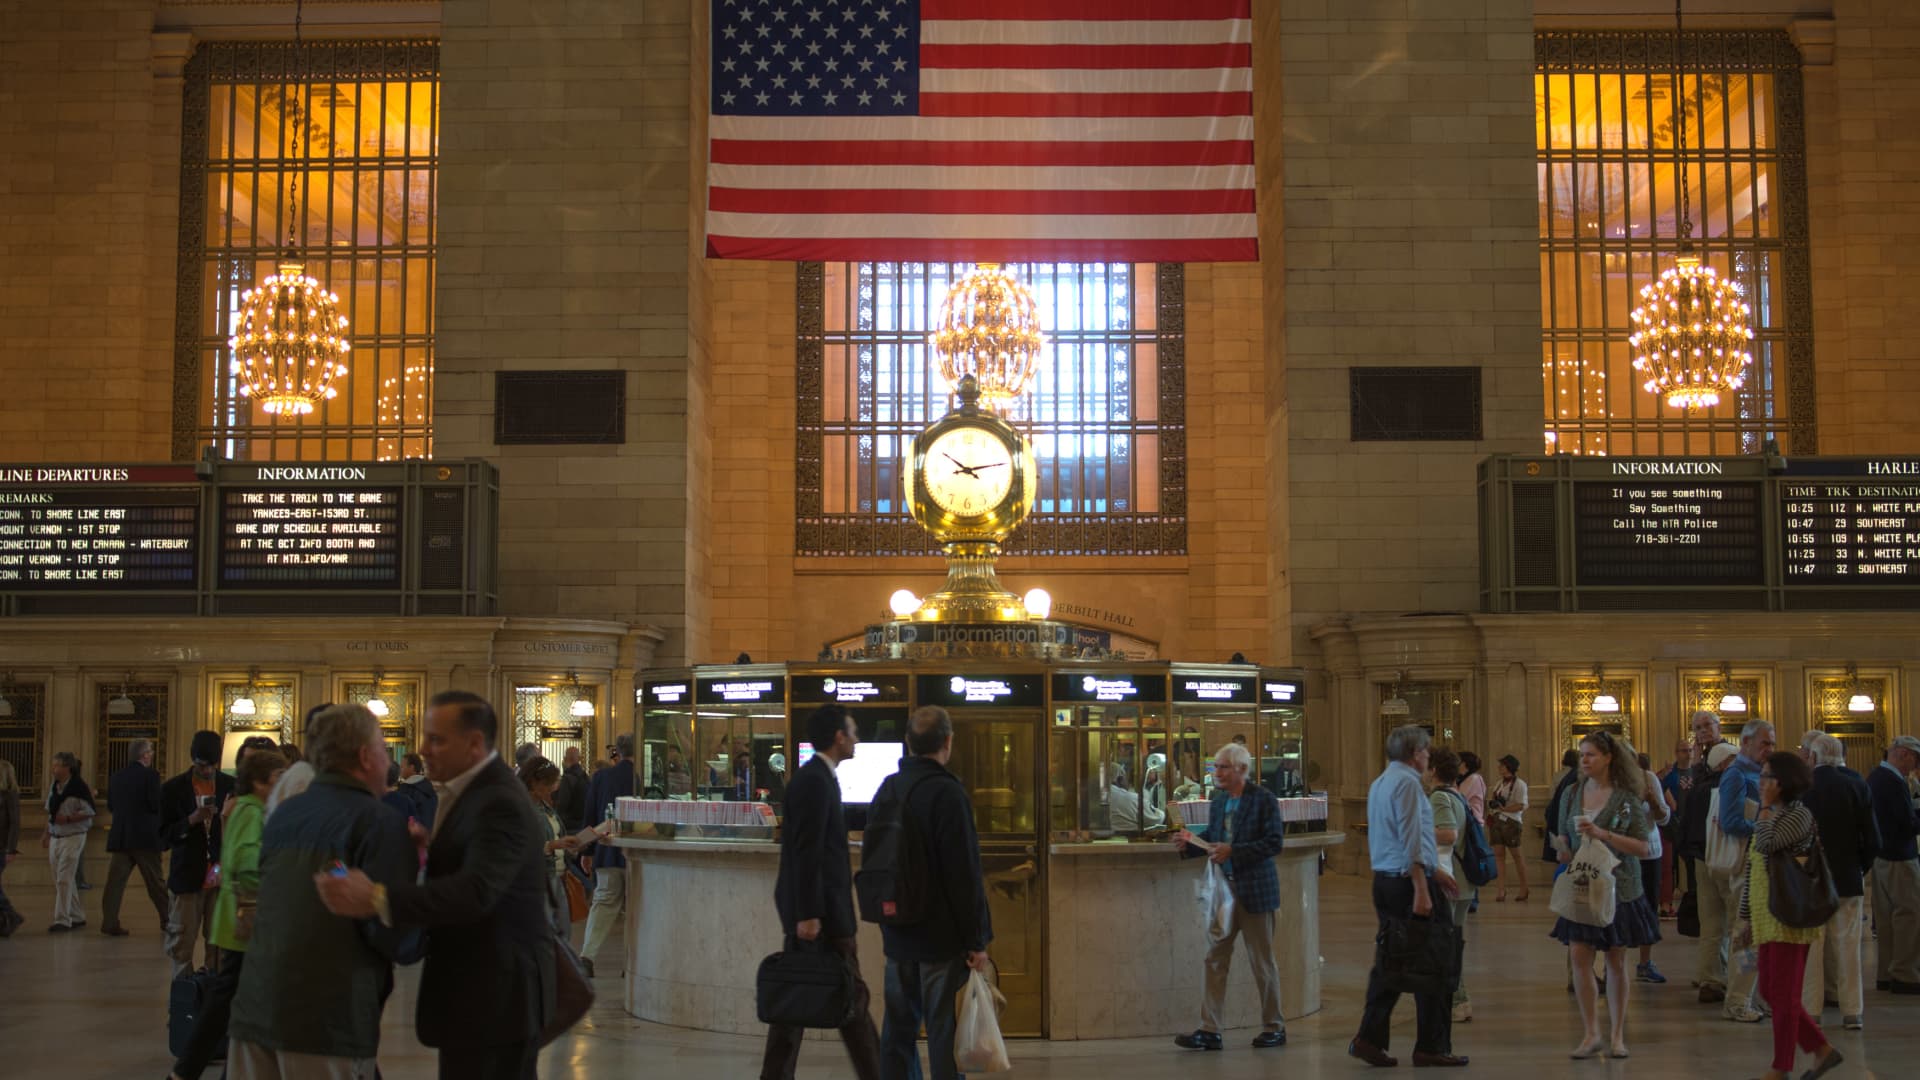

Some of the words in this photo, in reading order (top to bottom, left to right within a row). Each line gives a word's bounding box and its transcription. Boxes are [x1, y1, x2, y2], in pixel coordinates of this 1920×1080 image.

[257, 467, 367, 480] INFORMATION
[1612, 462, 1723, 475] INFORMATION
[0, 468, 33, 481] LINE
[37, 468, 129, 481] DEPARTURES
[1612, 488, 1623, 500] If
[1629, 488, 1646, 500] you
[1650, 488, 1668, 500] see
[1672, 488, 1723, 500] something
[1787, 486, 1817, 497] TIME
[1825, 486, 1851, 497] TRK
[0, 492, 54, 504] REMARKS
[241, 493, 264, 504] TAKE
[269, 493, 286, 504] THE
[291, 493, 318, 504] TRAIN
[322, 493, 334, 504] TO
[338, 493, 355, 504] THE
[359, 493, 382, 504] GAME
[353, 508, 370, 518] ST.
[1629, 503, 1647, 515] Say
[1651, 503, 1702, 515] Something
[1787, 503, 1814, 513] 10:25
[1830, 503, 1847, 513] 112
[1872, 503, 1900, 513] WHITE
[31, 509, 42, 520] TO
[46, 509, 74, 520] SHORE
[77, 509, 100, 520] LINE
[104, 509, 127, 520] EAST
[235, 523, 259, 534] GAME
[262, 523, 280, 534] DAY
[283, 523, 328, 534] SCHEDULE
[332, 523, 382, 534] AVAILABLE
[1613, 519, 1635, 529] Call
[1641, 519, 1658, 529] the
[1662, 519, 1680, 529] MTA
[1684, 519, 1718, 529] Police
[1787, 518, 1814, 528] 10:47
[1835, 518, 1847, 528] 29
[1857, 518, 1906, 528] SOUTHEAST
[30, 524, 63, 535] VERNON
[78, 524, 94, 535] 1ST
[98, 524, 121, 535] STOP
[1788, 533, 1815, 543] 10:55
[1831, 533, 1848, 543] 109
[1873, 533, 1901, 543] WHITE
[56, 539, 67, 550] TO
[71, 539, 89, 550] NEW
[92, 539, 126, 550] CANAAN
[140, 539, 189, 550] WATERBURY
[240, 539, 253, 549] AT
[257, 539, 274, 549] THE
[299, 539, 322, 549] INFO
[326, 539, 354, 549] BOOTH
[358, 539, 376, 549] AND
[29, 554, 62, 565] VERNON
[77, 554, 93, 565] 1ST
[97, 554, 120, 565] STOP
[266, 554, 279, 564] AT
[1788, 549, 1816, 559] 11:25
[1836, 549, 1848, 559] 33
[1874, 549, 1903, 559] WHITE
[28, 569, 40, 580] TO
[44, 569, 72, 580] SHORE
[76, 569, 98, 580] LINE
[102, 569, 125, 580] EAST
[1788, 564, 1816, 574] 11:47
[1836, 564, 1849, 574] 32
[1858, 564, 1908, 574] SOUTHEAST
[1103, 609, 1135, 628] HALL
[933, 624, 1038, 643] Information
[374, 639, 409, 651] TOURS
